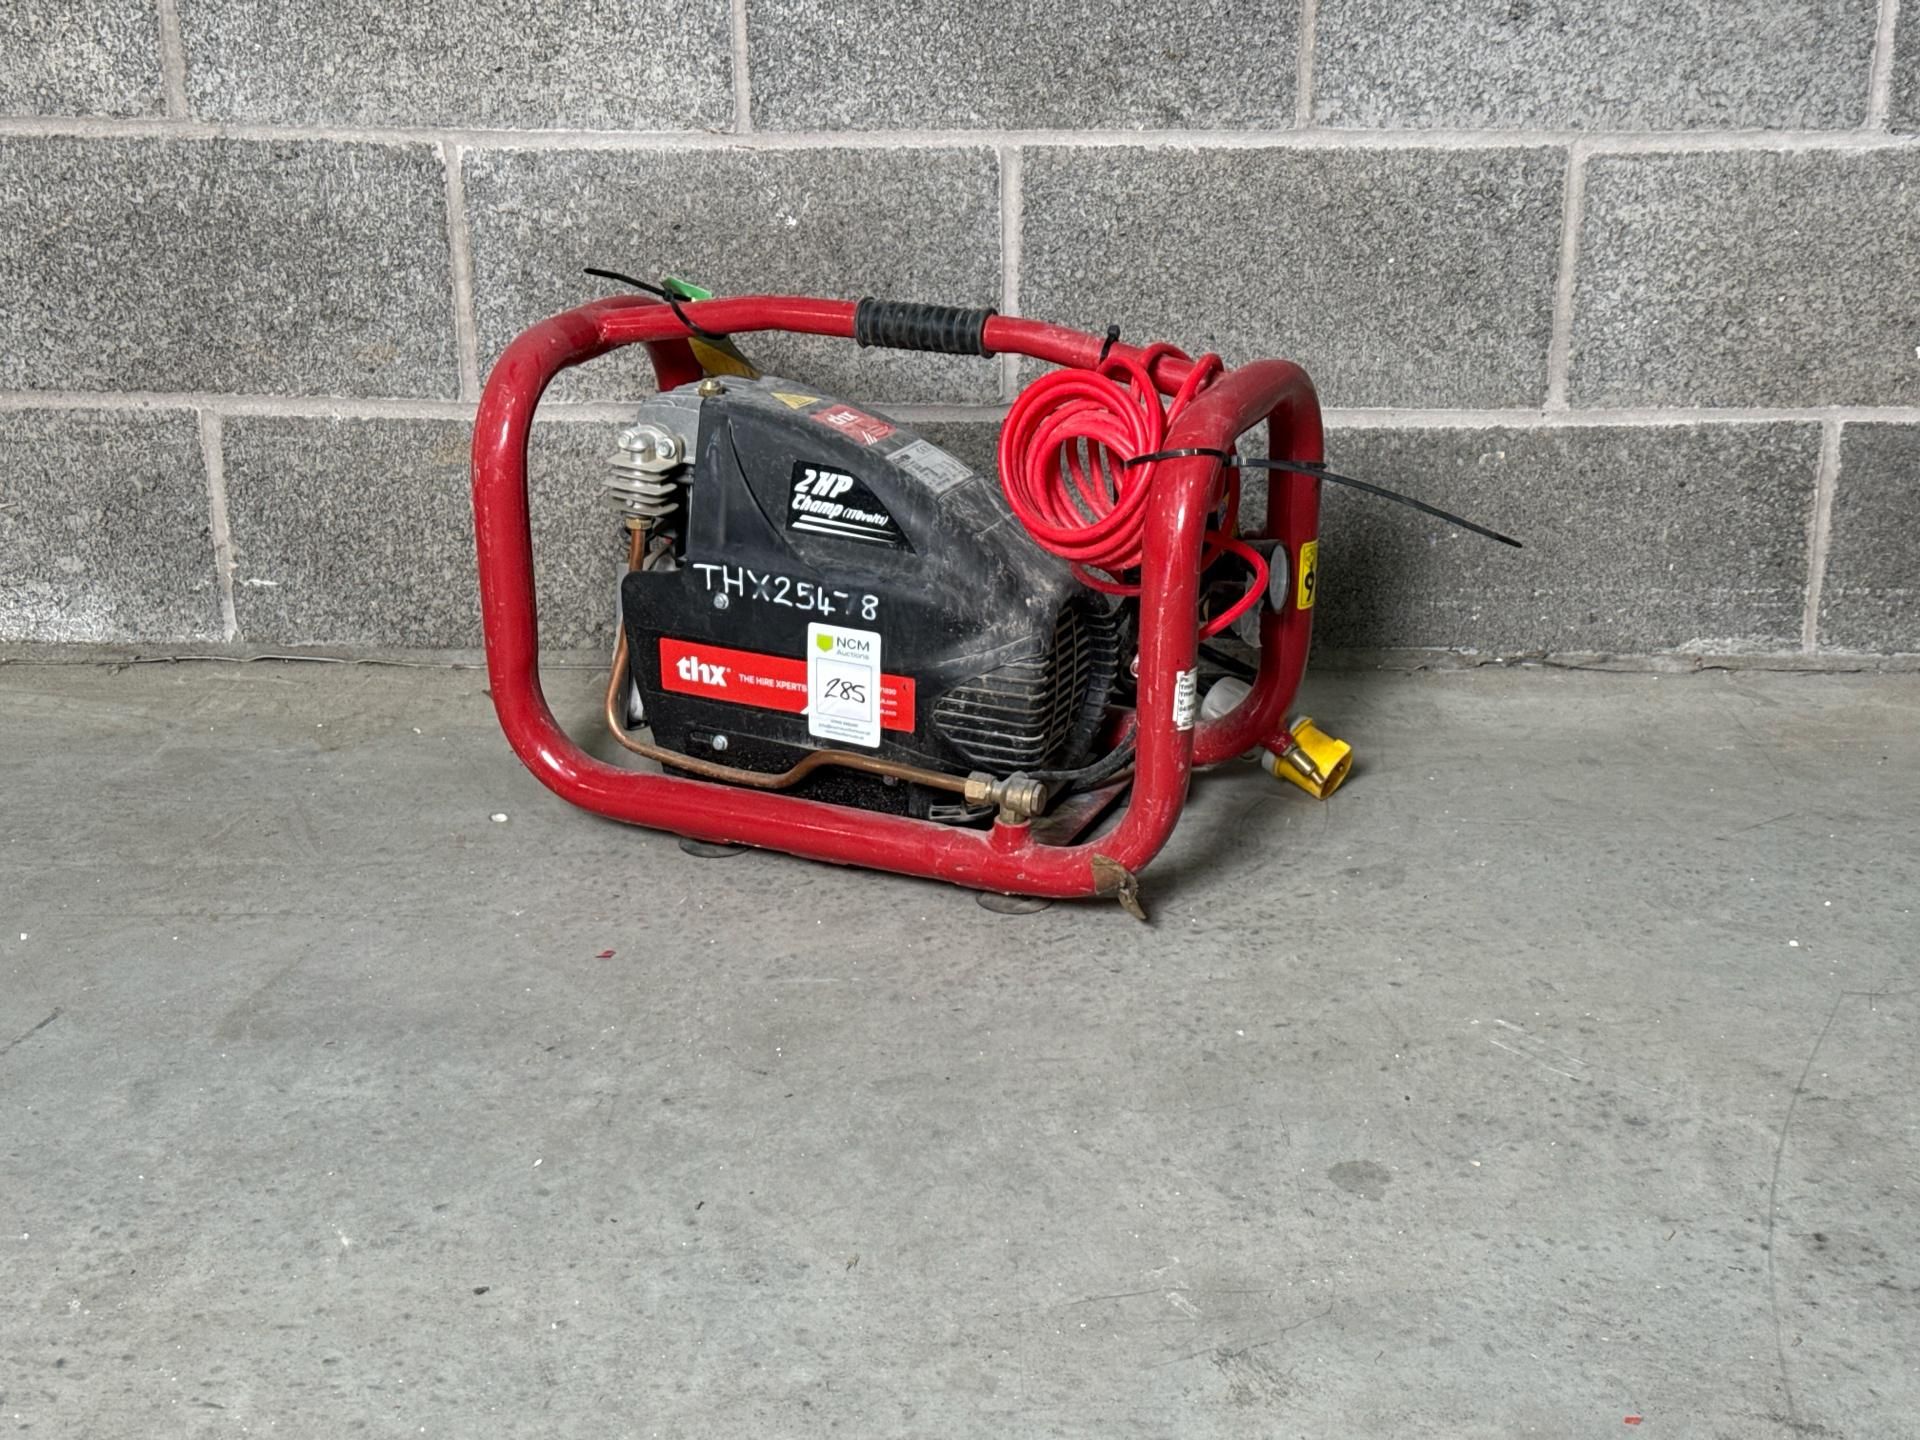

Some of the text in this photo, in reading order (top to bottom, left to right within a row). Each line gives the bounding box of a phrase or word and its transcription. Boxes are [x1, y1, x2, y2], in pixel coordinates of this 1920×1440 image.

[794, 468, 854, 499] 2HP
[791, 493, 889, 527] Champ (110volts)
[836, 636, 870, 652] NCM
[836, 649, 870, 660] Auctions
[676, 655, 808, 693] thx THE HIRE XPERTS
[824, 677, 866, 704] 285
